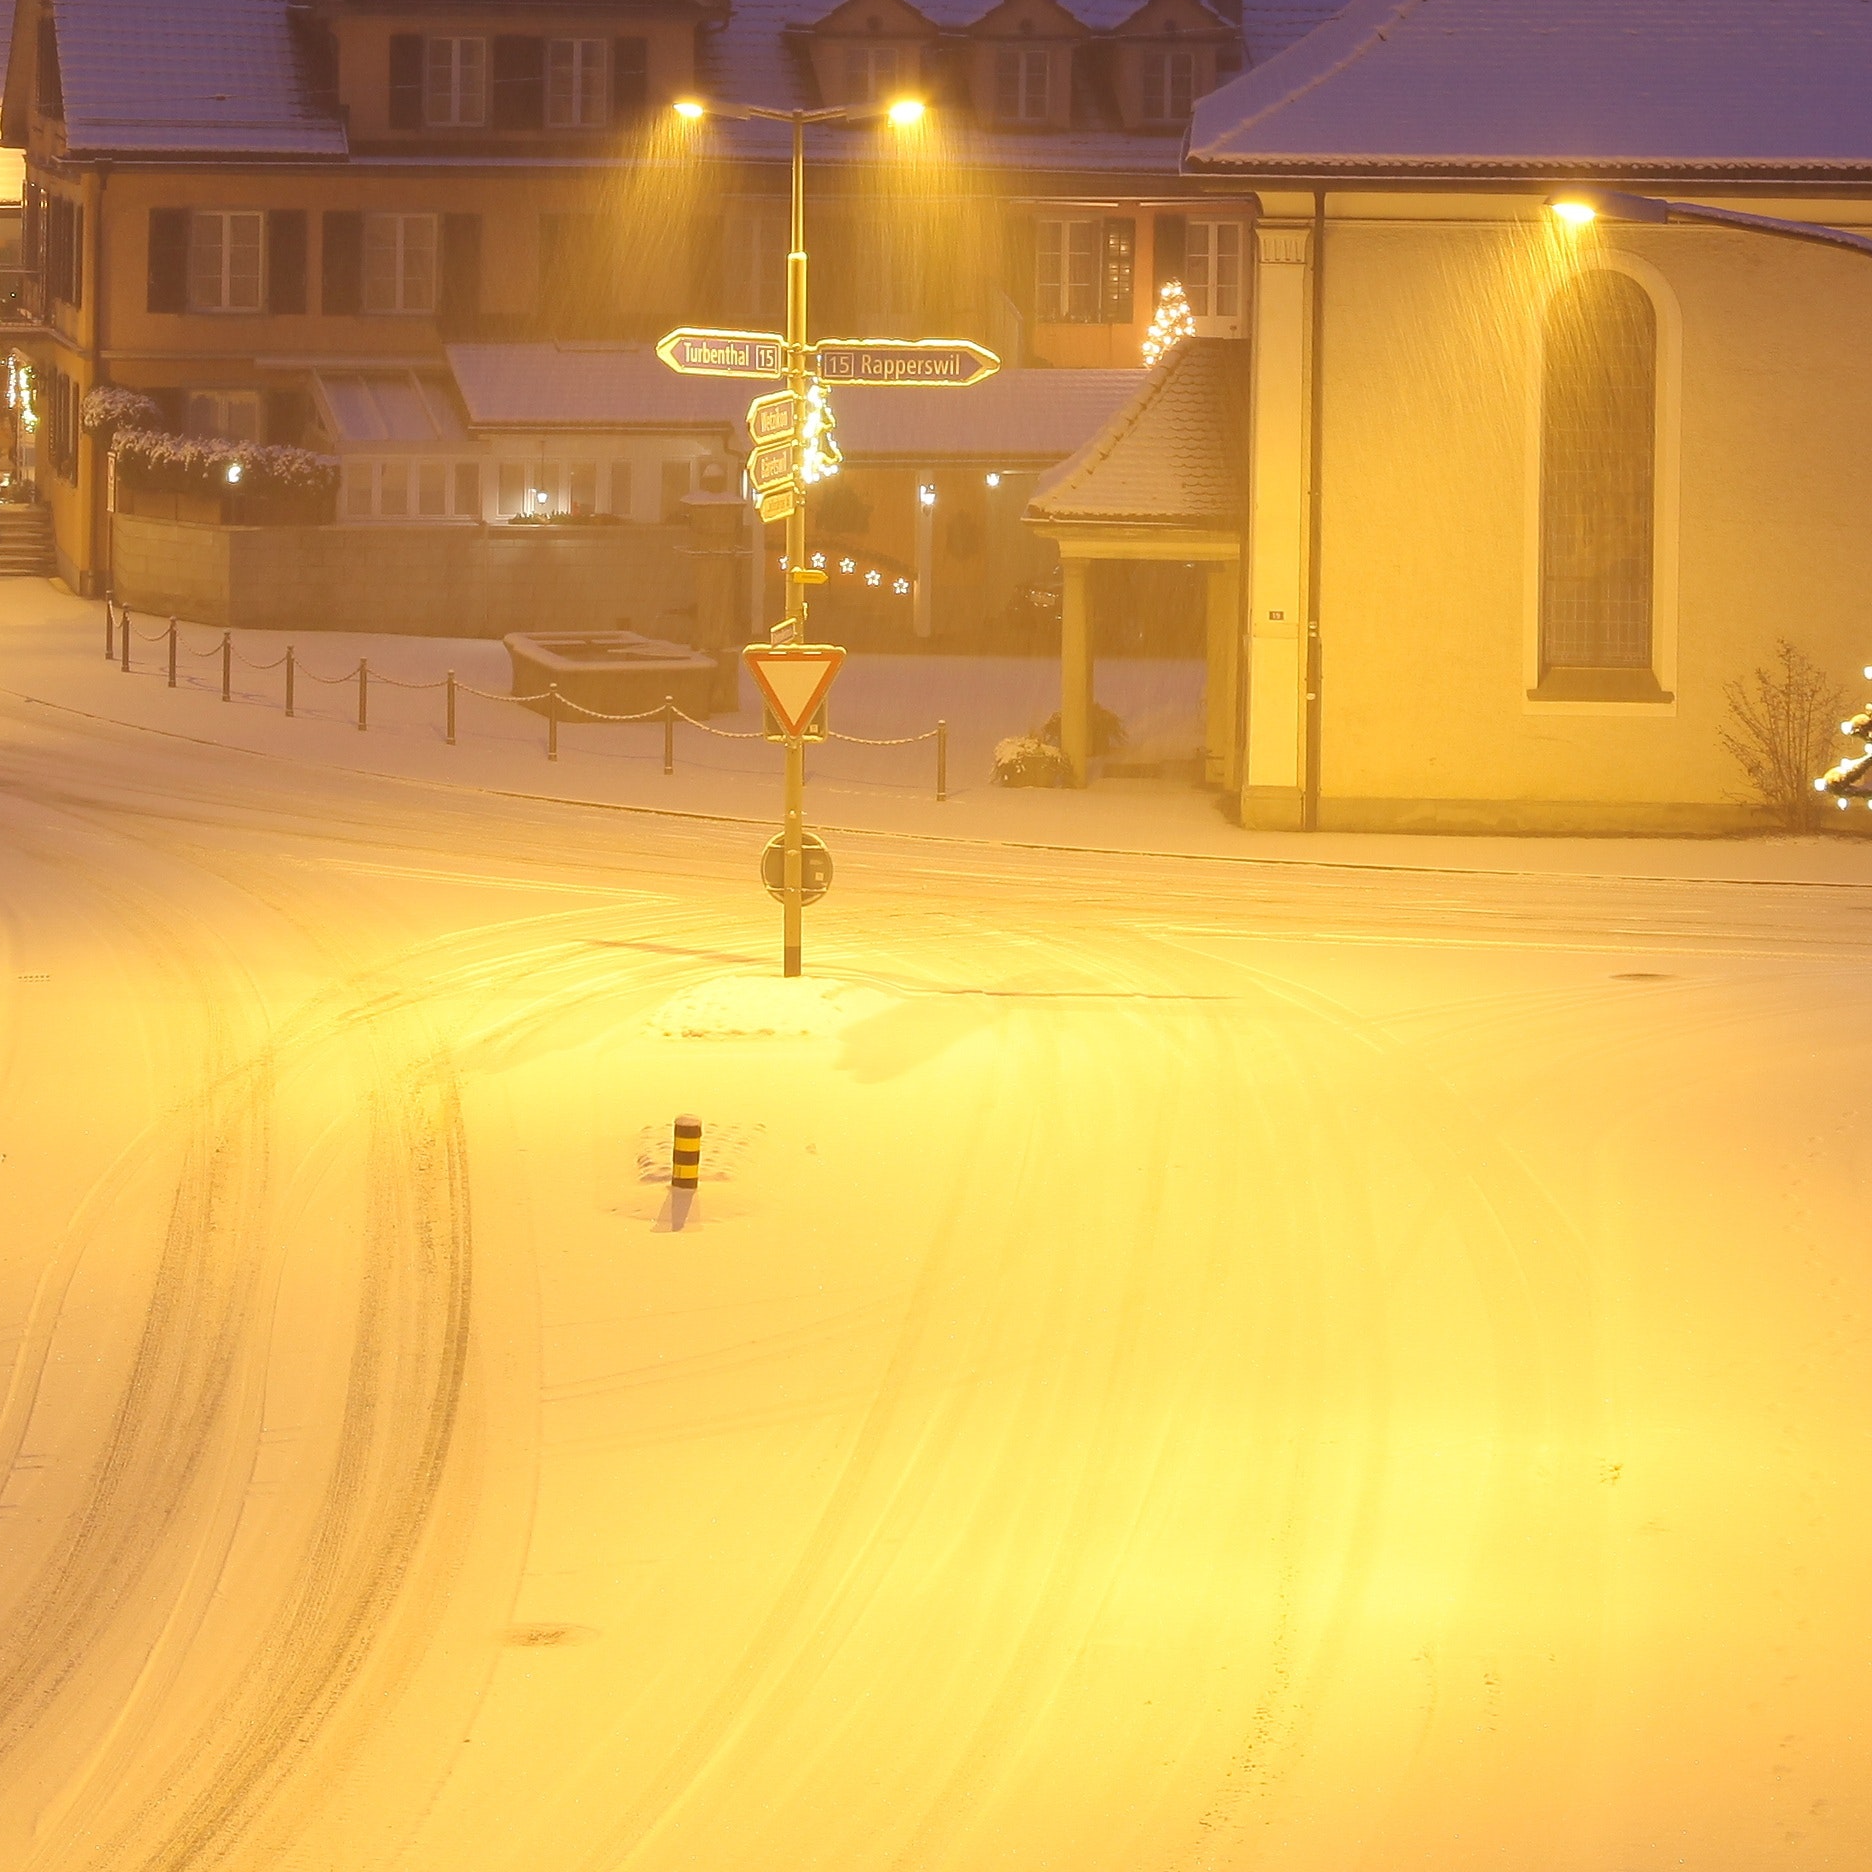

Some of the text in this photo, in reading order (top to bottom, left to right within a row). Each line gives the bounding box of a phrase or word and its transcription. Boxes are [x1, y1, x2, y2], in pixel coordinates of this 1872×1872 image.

[683, 341, 774, 367] Turbenthal 15
[829, 354, 960, 379] 15 Rapperswil
